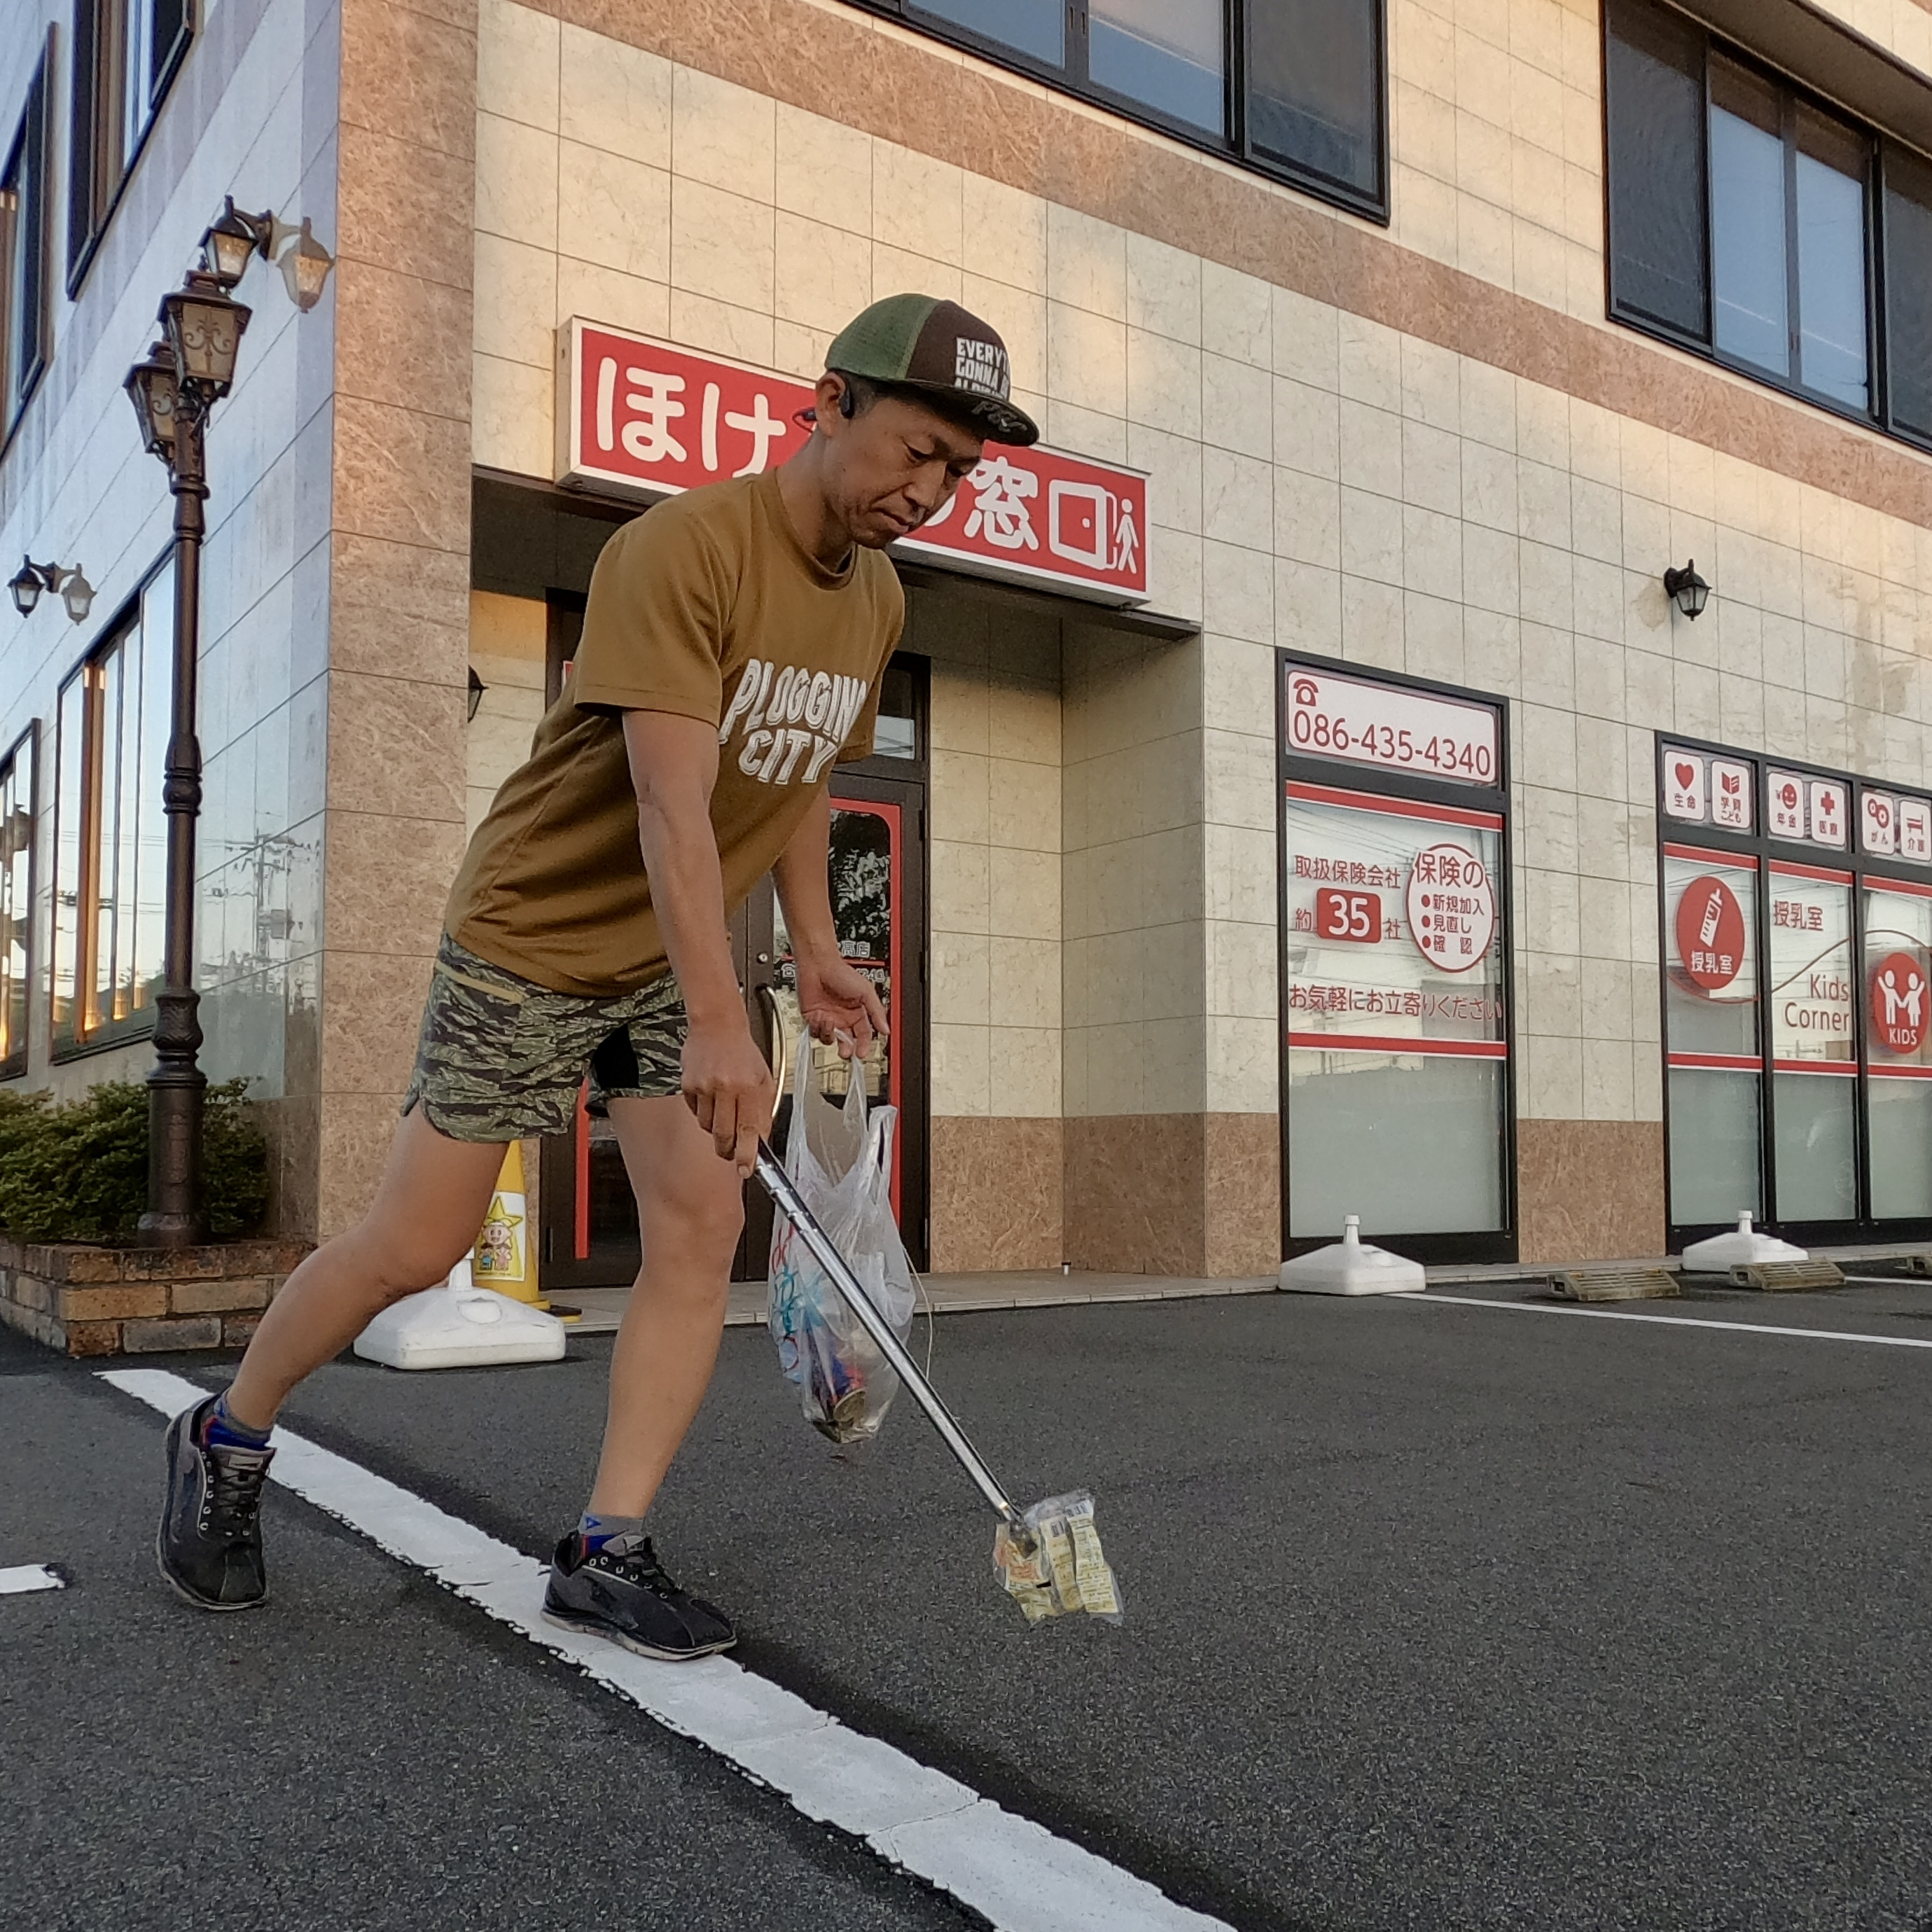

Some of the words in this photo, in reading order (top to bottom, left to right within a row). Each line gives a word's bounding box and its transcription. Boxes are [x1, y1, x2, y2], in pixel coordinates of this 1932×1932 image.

[955, 356, 999, 391] GONNA
[738, 728, 838, 785] CITY
[1294, 709, 1491, 776] 086-435-4340
[1293, 854, 1401, 889] 取扱保険会社
[1415, 852, 1485, 889] 保険の
[1295, 907, 1313, 932] 約
[1328, 894, 1370, 938] 35
[1385, 917, 1401, 940] 社
[1433, 914, 1472, 934] 見直し
[1773, 899, 1824, 931] 授乳室
[1690, 950, 1733, 975] 授乳室
[1288, 983, 1503, 1021] お気軽にお立寄りください
[1810, 973, 1849, 1002] Kids
[1785, 1001, 1850, 1032] Corner
[1889, 1027, 1918, 1045] KIDS
